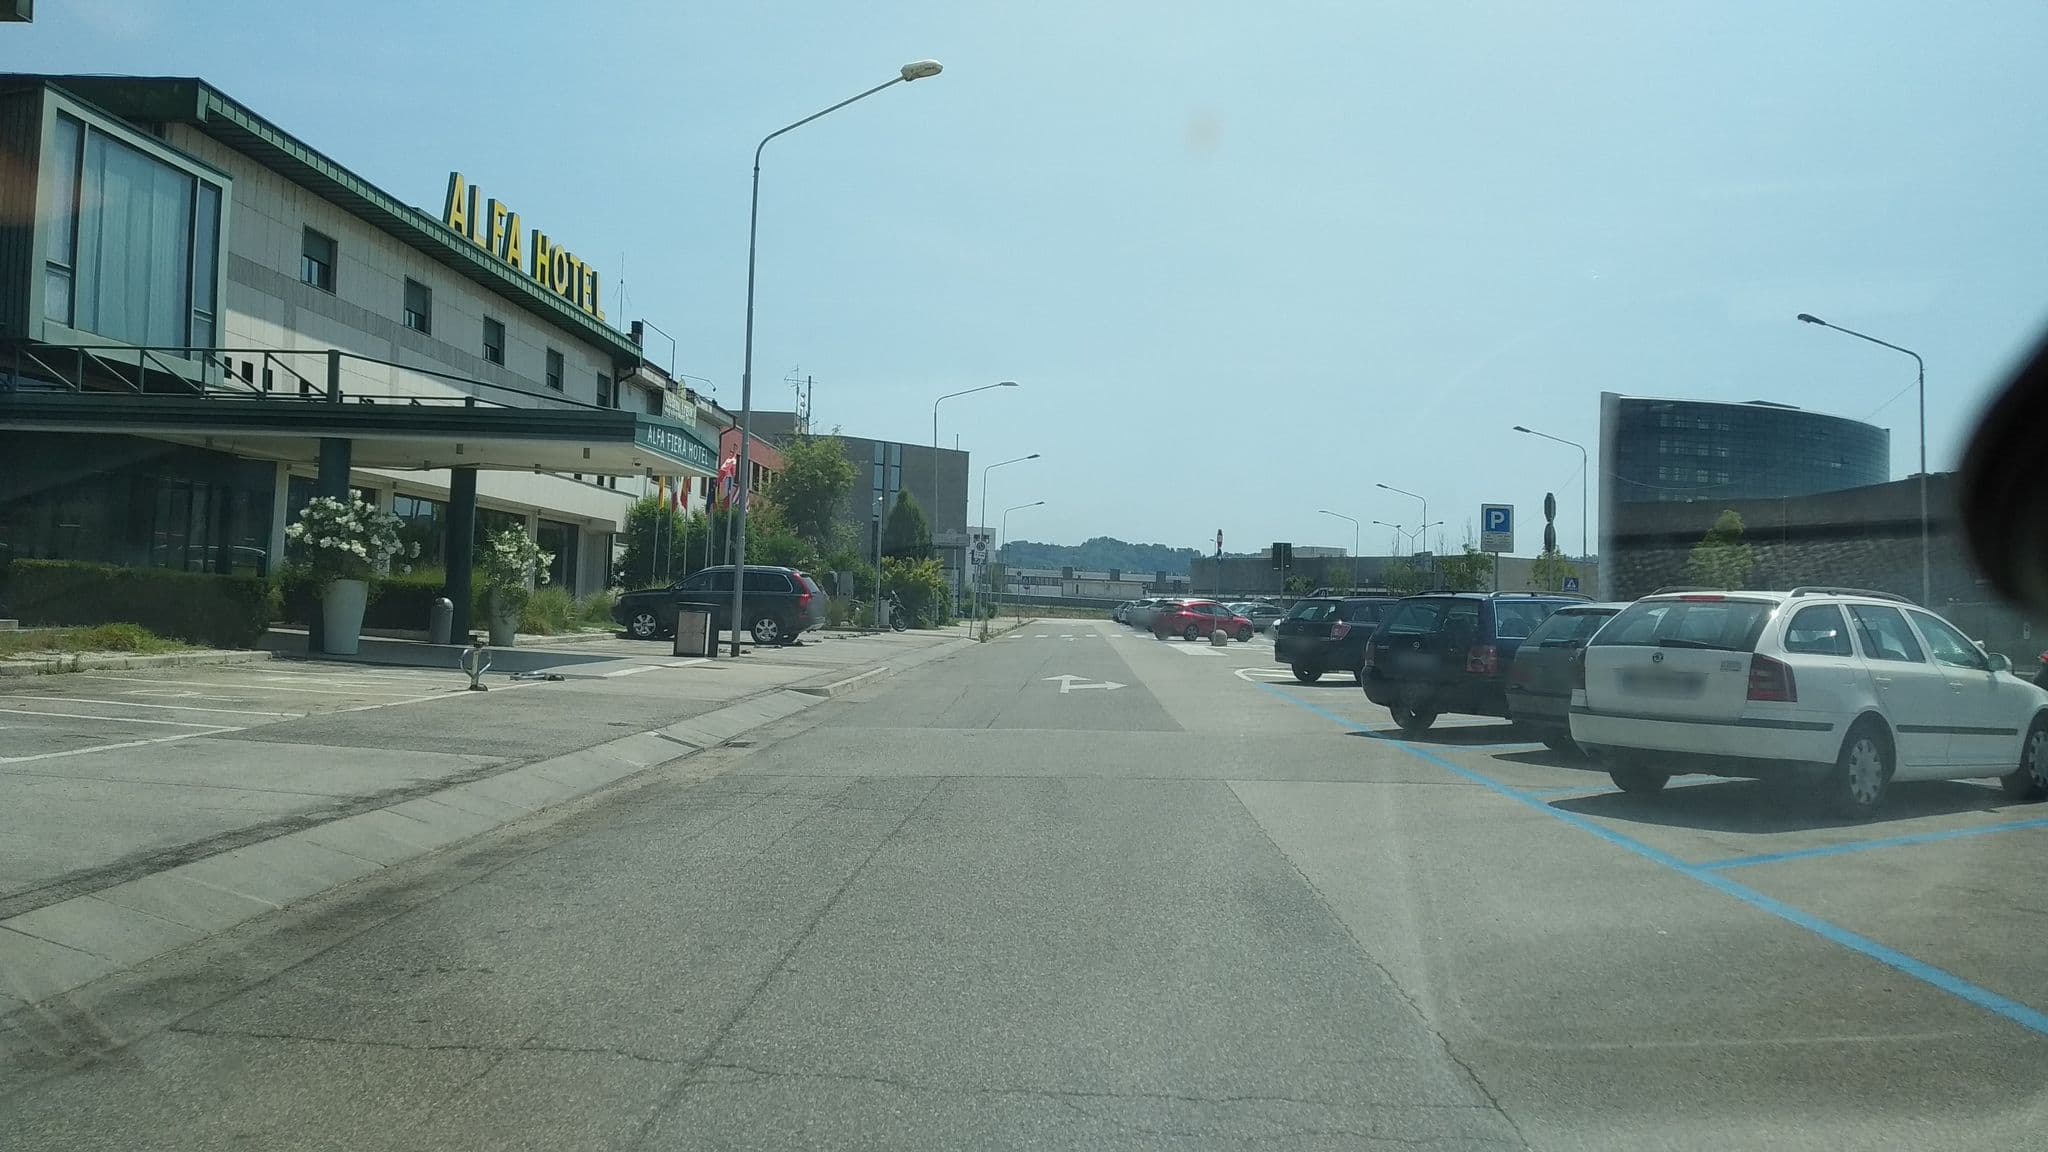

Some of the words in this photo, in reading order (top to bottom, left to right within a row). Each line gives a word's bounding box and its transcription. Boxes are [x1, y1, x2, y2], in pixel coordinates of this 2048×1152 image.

[443, 172, 523, 271] ALFA
[531, 229, 605, 321] HOTEL
[647, 424, 665, 448] ALFA
[667, 432, 687, 457] FIERA
[688, 443, 709, 465] HOTEL
[1490, 511, 1505, 529] P
